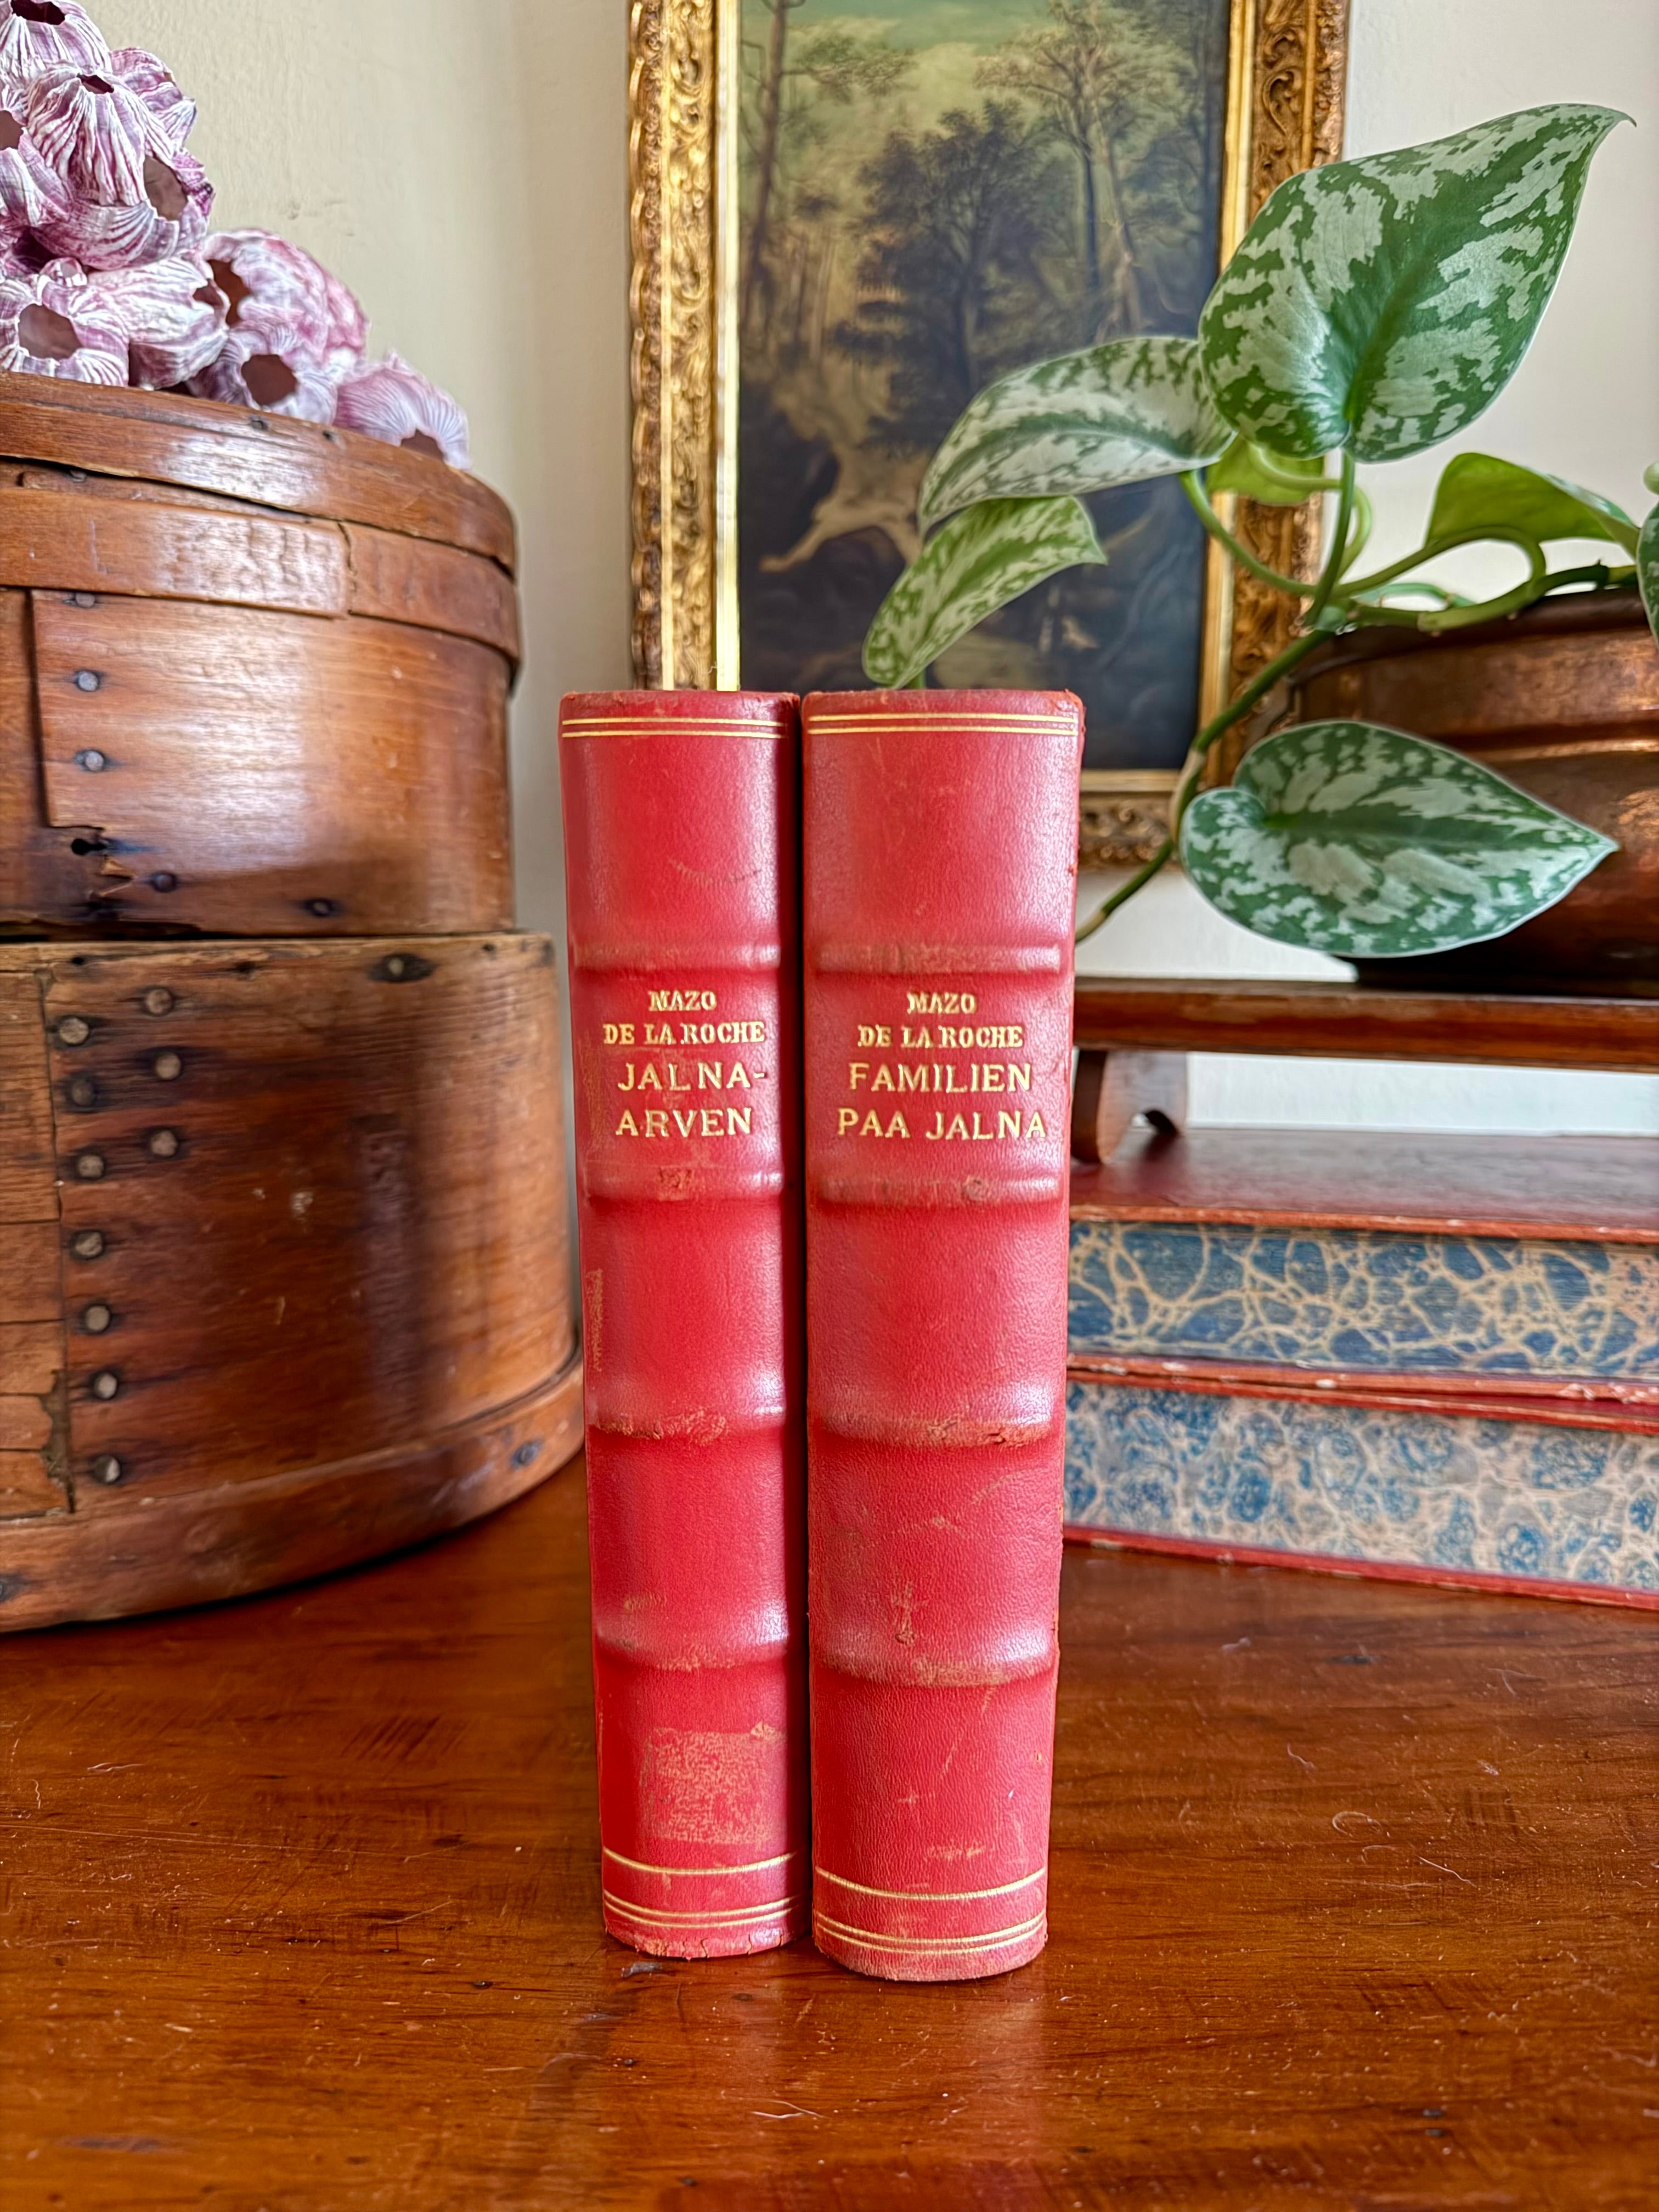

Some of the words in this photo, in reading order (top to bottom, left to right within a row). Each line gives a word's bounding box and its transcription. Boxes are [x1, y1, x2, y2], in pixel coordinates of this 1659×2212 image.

[648, 990, 717, 1011] MAZO
[907, 992, 977, 1014] MAZO
[603, 1023, 635, 1045] DE
[644, 1023, 676, 1045] LA
[680, 1021, 765, 1045] ROCHE
[857, 1025, 891, 1047] DE
[901, 1026, 933, 1048] LA
[938, 1025, 1023, 1048] ROCHE
[618, 1062, 765, 1091] JALNA-
[849, 1062, 1031, 1093] FAMILIEN
[616, 1107, 752, 1137] ARVEN
[838, 1108, 910, 1138] PAA
[926, 1110, 1046, 1140] JALNA
